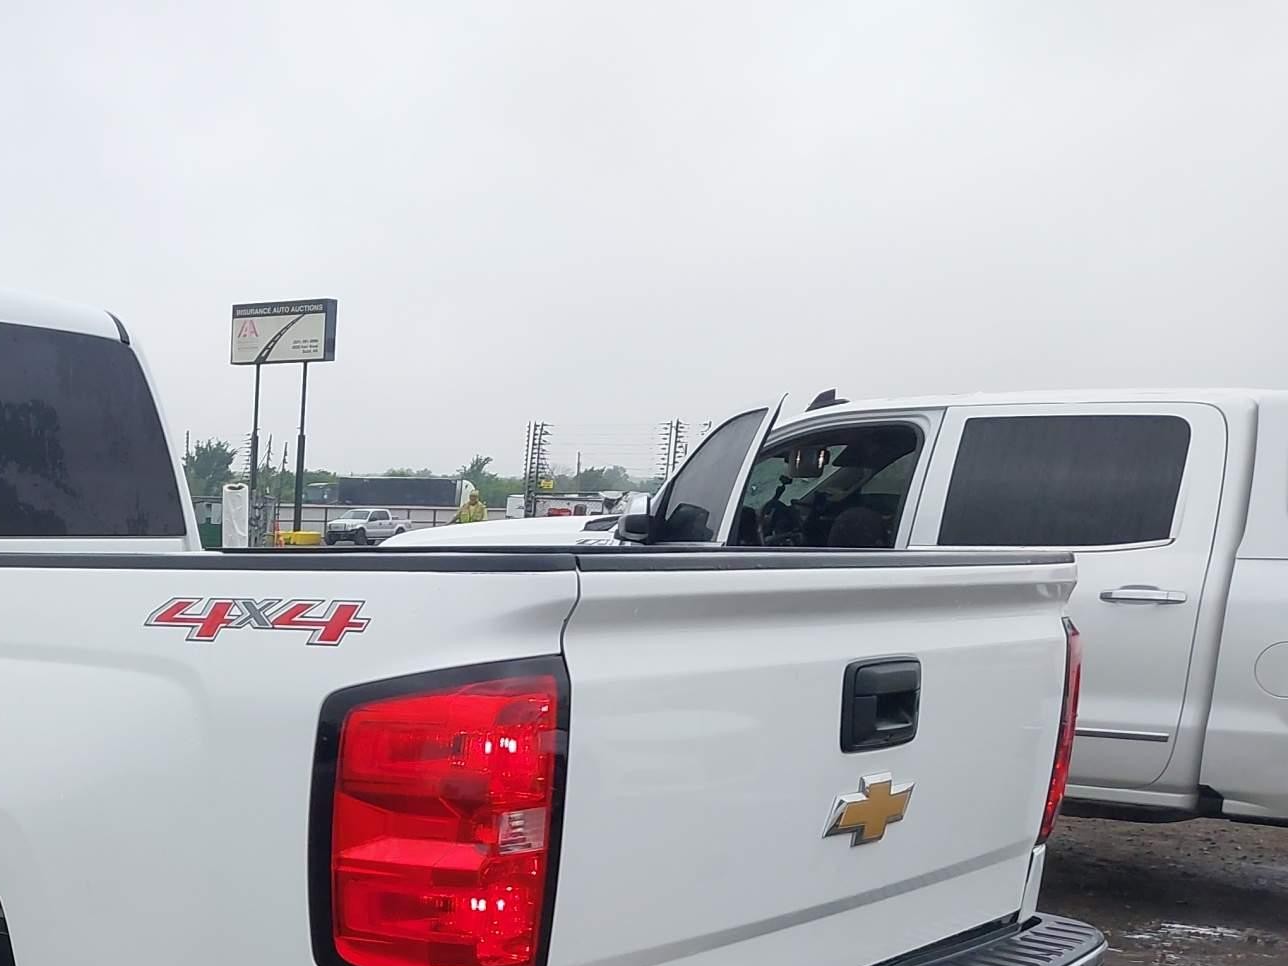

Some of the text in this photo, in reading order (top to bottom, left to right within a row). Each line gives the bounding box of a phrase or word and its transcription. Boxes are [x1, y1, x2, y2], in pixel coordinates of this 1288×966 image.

[236, 304, 323, 316] INSURANCE AUTO AUCTIONS
